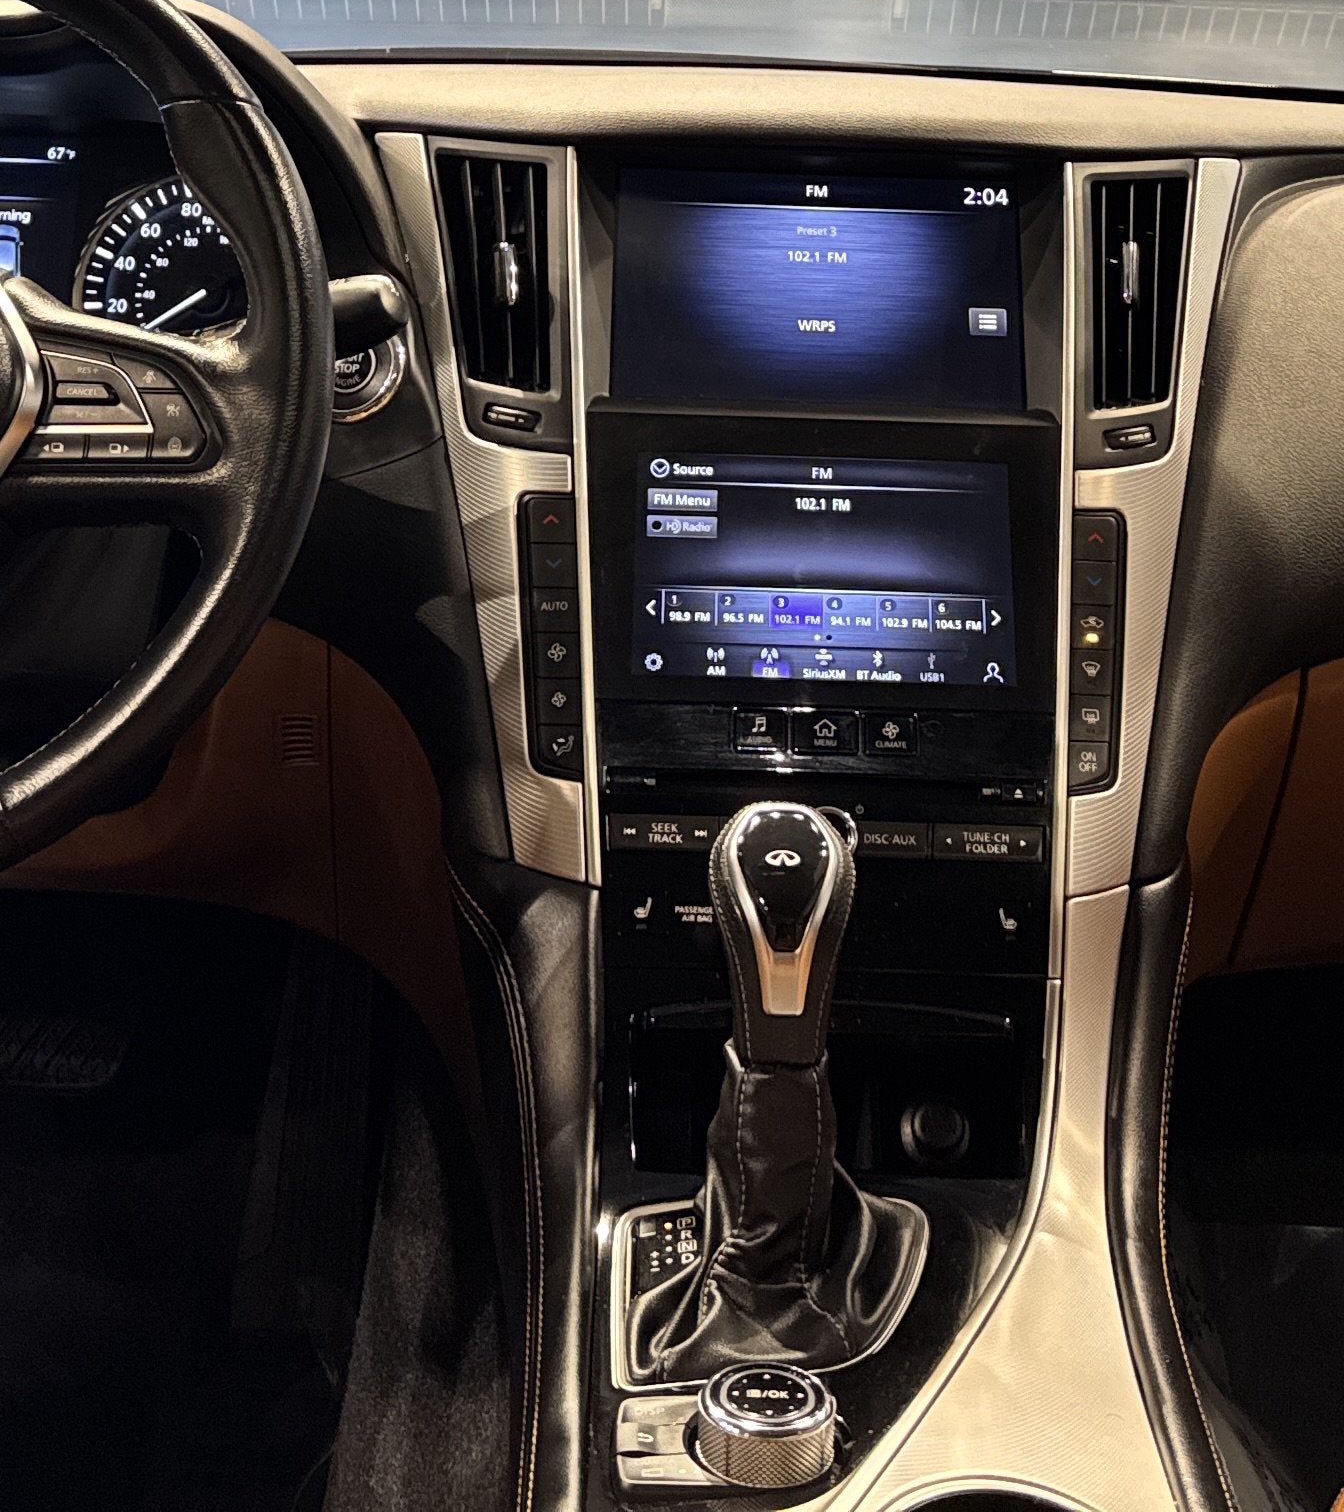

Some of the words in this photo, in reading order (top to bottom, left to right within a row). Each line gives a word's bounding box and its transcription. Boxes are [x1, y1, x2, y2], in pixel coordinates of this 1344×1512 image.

[805, 184, 829, 199] FM
[963, 187, 1009, 207] 2:04
[180, 202, 202, 217] 80
[140, 222, 161, 238] 60
[796, 225, 827, 237] Preset
[829, 225, 838, 238] 3
[183, 237, 198, 247] 120
[787, 250, 821, 263] 102.1
[826, 251, 847, 264] FM
[114, 255, 136, 271] 40
[142, 289, 156, 300] 40
[107, 298, 128, 314] 20
[797, 319, 836, 333] WRPS
[66, 388, 98, 396] CANCEL
[672, 463, 714, 476] Source
[811, 467, 833, 480] FM
[653, 493, 673, 505] FM
[675, 494, 711, 507] Menu
[795, 497, 826, 511] 102.1
[832, 498, 851, 512] FM
[682, 521, 712, 533] Radio
[671, 594, 677, 605] 1
[724, 596, 732, 606] 2
[777, 598, 785, 608] 3
[831, 599, 838, 609] 4
[540, 601, 569, 612] AUTO
[885, 601, 892, 611] 5
[937, 603, 946, 613] 6
[669, 611, 691, 622] 98.9
[694, 612, 711, 622] FM
[722, 612, 744, 623] 96.5
[748, 613, 764, 624] FM
[774, 614, 800, 624] 102.1
[805, 615, 821, 625] FM
[830, 616, 851, 626] 94.1
[856, 616, 872, 627] FM
[881, 617, 908, 628] 102.9
[912, 618, 928, 629] FM
[935, 619, 962, 630] 104.5
[965, 620, 982, 631] FM
[706, 665, 726, 676] AM
[762, 666, 778, 677] FM
[803, 668, 846, 679] SiriusXM
[856, 670, 869, 680] BT
[870, 670, 902, 681] Audio
[920, 672, 945, 682] USB1
[814, 738, 838, 747] MENU
[875, 740, 907, 749] CLIMATE
[1080, 751, 1097, 762] ON
[1078, 761, 1098, 773] OFF
[651, 823, 679, 834] SEEK
[647, 832, 684, 844] TRACK
[965, 842, 1009, 855] FOLDER
[682, 1218, 692, 1227] P
[680, 1229, 692, 1240] R
[682, 1241, 692, 1250] N
[680, 1252, 695, 1265] D
[634, 1407, 665, 1416] DISP
